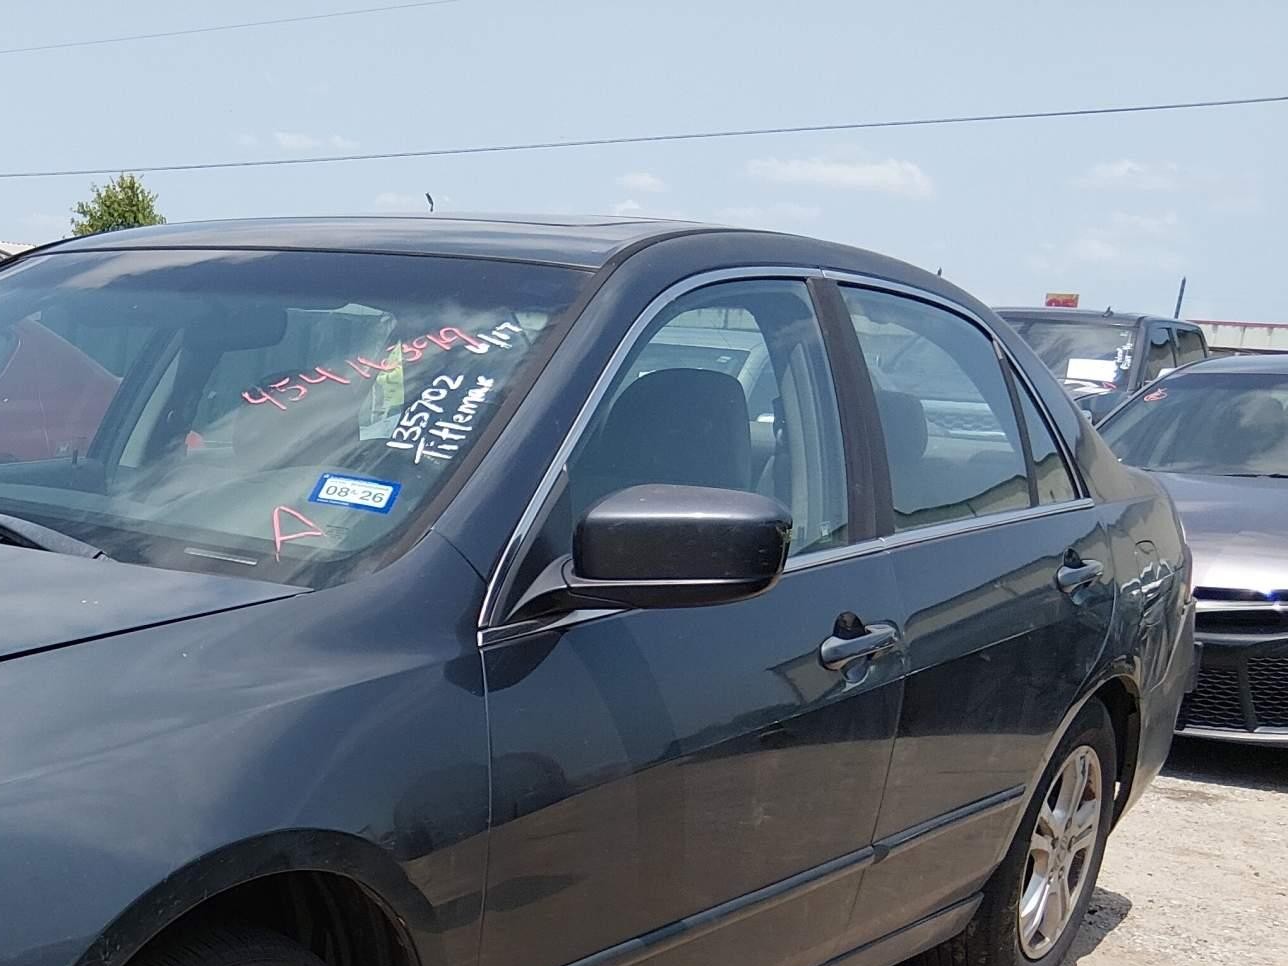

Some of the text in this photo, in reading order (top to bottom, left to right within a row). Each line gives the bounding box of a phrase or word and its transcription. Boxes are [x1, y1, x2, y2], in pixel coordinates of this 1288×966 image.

[386, 374, 464, 449] 135702
[325, 485, 350, 498] 08
[359, 490, 385, 504] 26
